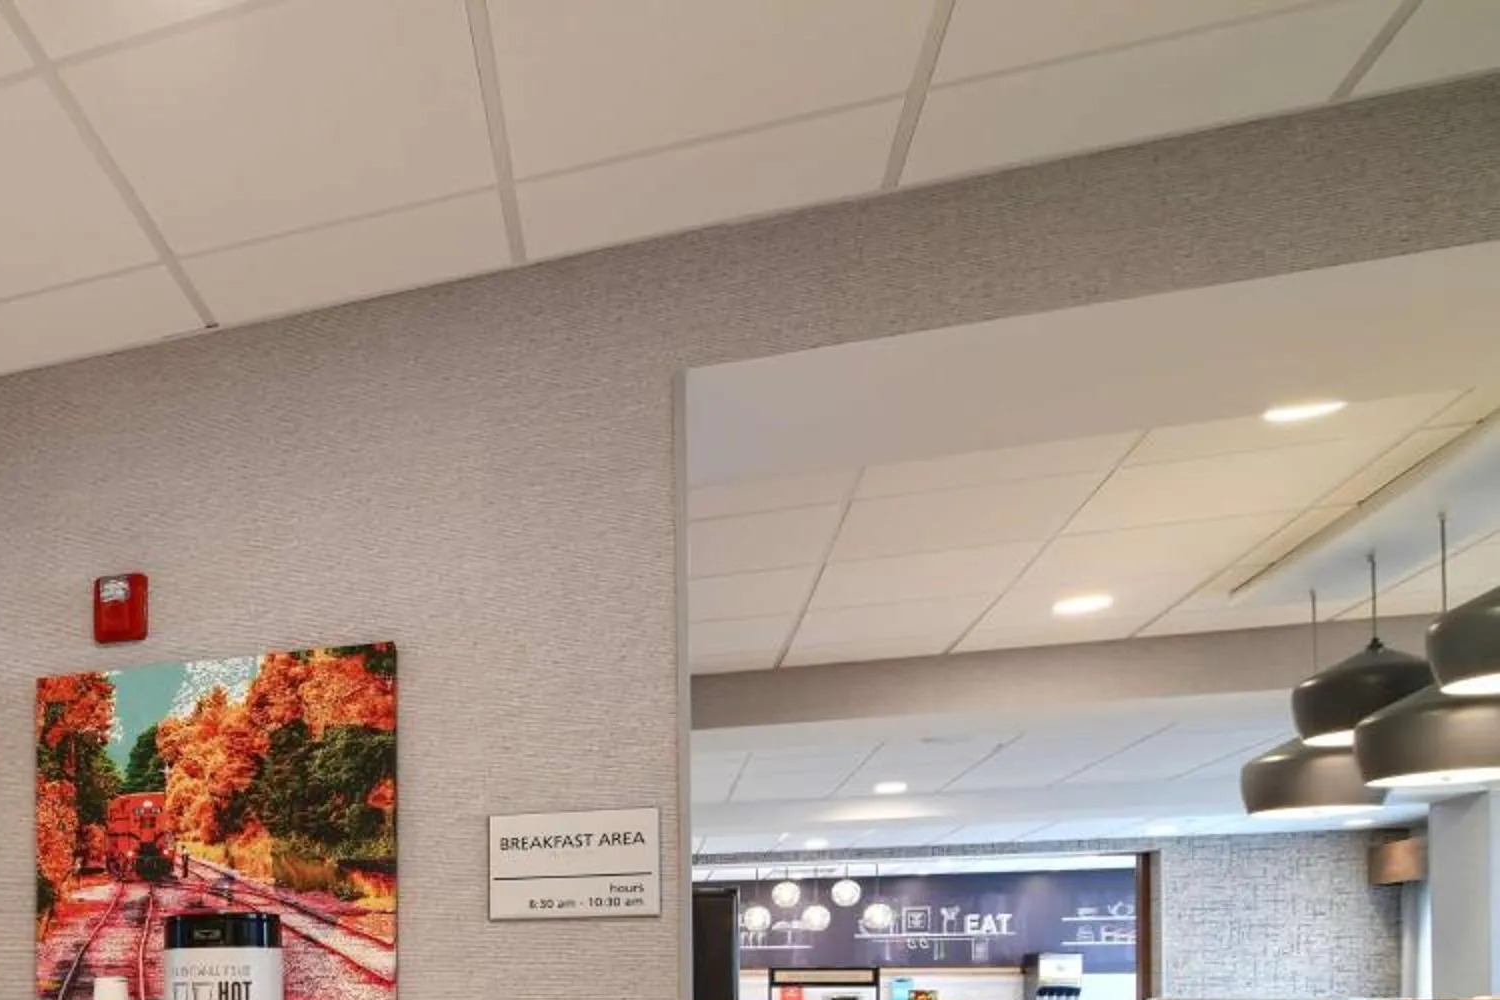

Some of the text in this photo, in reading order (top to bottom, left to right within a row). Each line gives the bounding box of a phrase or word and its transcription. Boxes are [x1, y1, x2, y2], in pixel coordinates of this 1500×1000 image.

[500, 831, 645, 851] BREAKFAST AREA
[609, 883, 644, 893] hours
[557, 899, 576, 909] am
[588, 897, 621, 908] 10:30
[625, 897, 644, 907] am
[964, 913, 1012, 935] EAT
